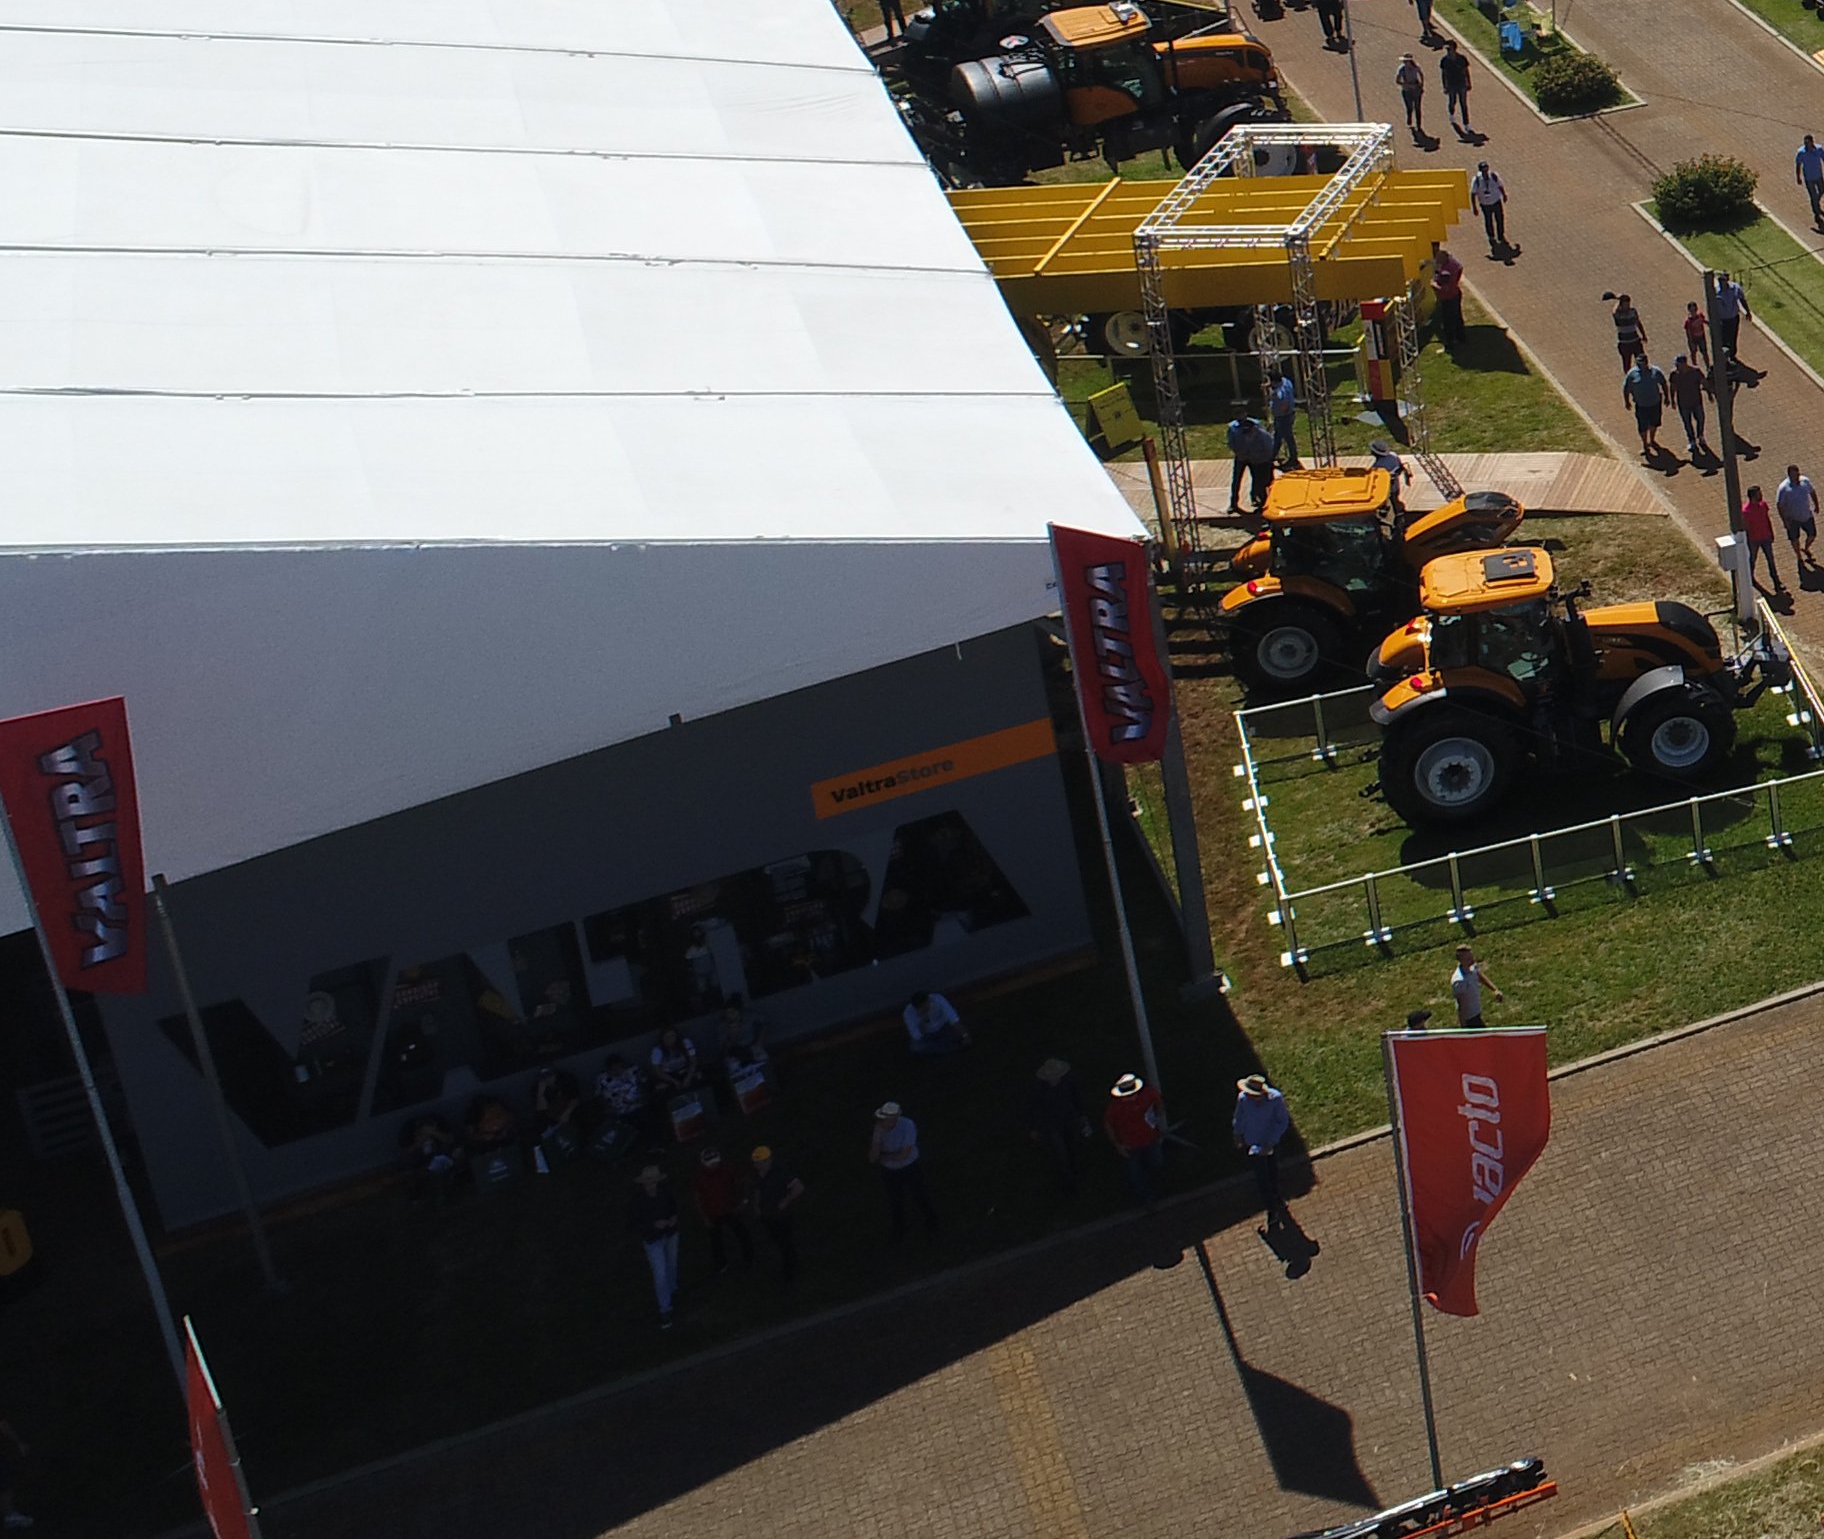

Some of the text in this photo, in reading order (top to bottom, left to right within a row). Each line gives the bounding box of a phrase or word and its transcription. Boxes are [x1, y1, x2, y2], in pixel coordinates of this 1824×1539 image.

[1084, 558, 1159, 746] VALTRA
[38, 726, 122, 970] VALTRA
[831, 758, 957, 805] ValtraStore
[158, 808, 1033, 1148] VALTRA
